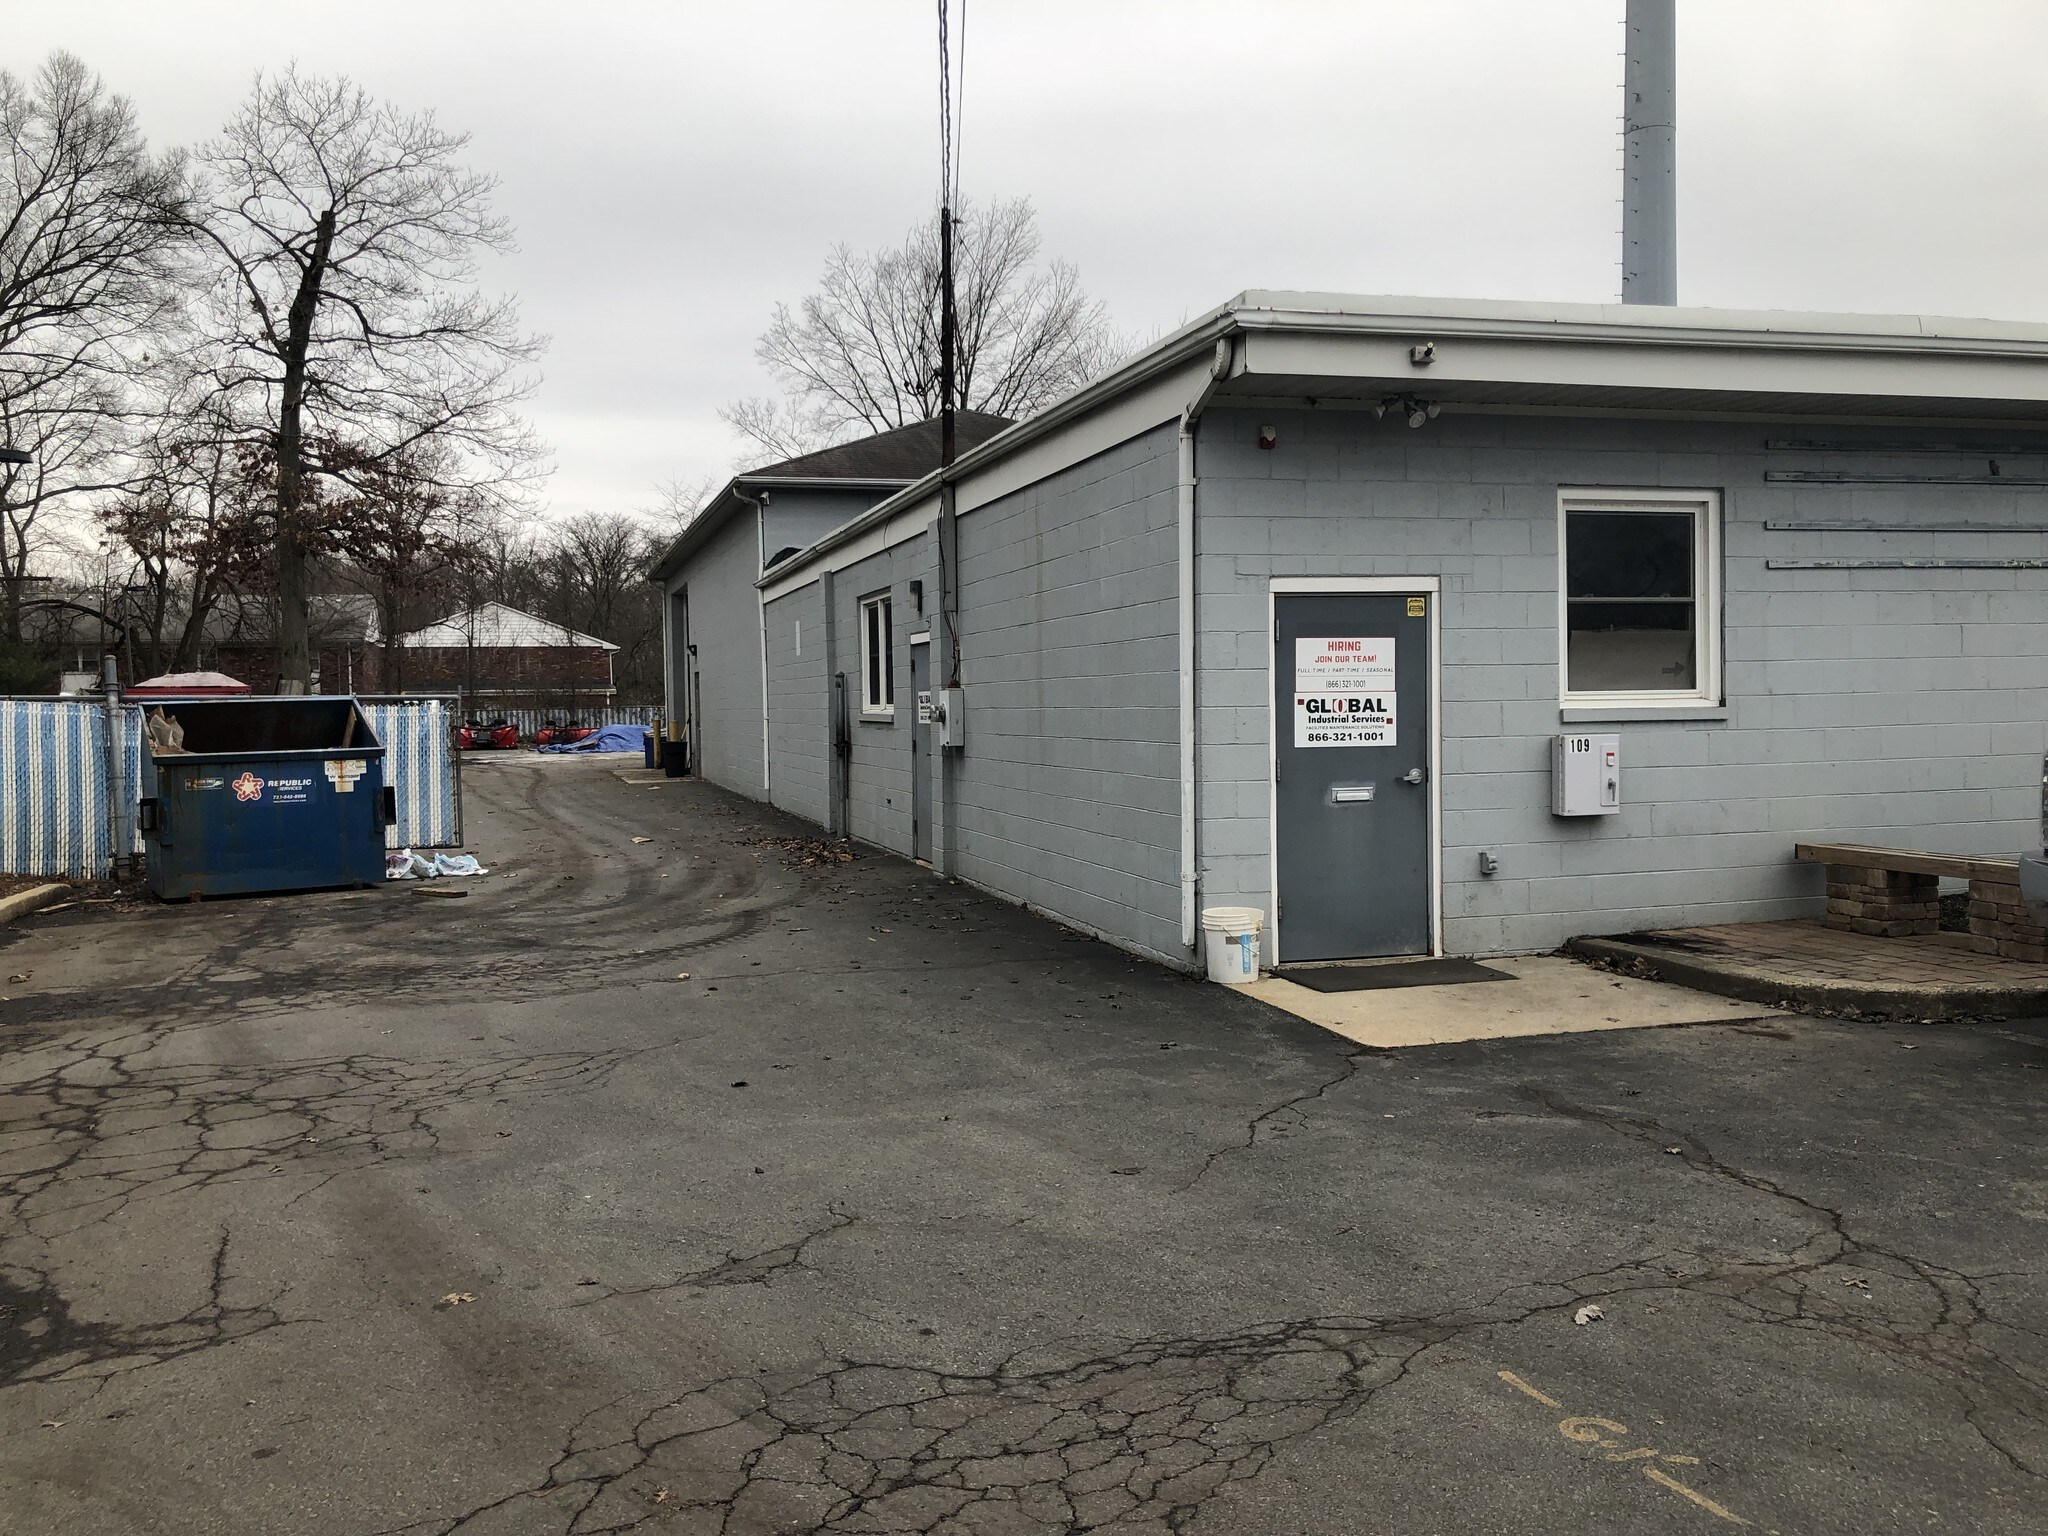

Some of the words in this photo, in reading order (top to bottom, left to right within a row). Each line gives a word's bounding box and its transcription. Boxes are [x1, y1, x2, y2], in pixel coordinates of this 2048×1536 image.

[1327, 641, 1361, 652] HIRING
[1315, 655, 1332, 663] JOIN
[1335, 655, 1350, 663] OUR
[1352, 654, 1377, 663] TEAM!
[1305, 698, 1388, 714] GLOBAL
[1308, 714, 1349, 723] Industrial
[1351, 714, 1385, 723] Services
[1308, 732, 1384, 742] 866-321-1001
[1571, 738, 1590, 753] 109
[267, 778, 312, 787] REPUBLIC
